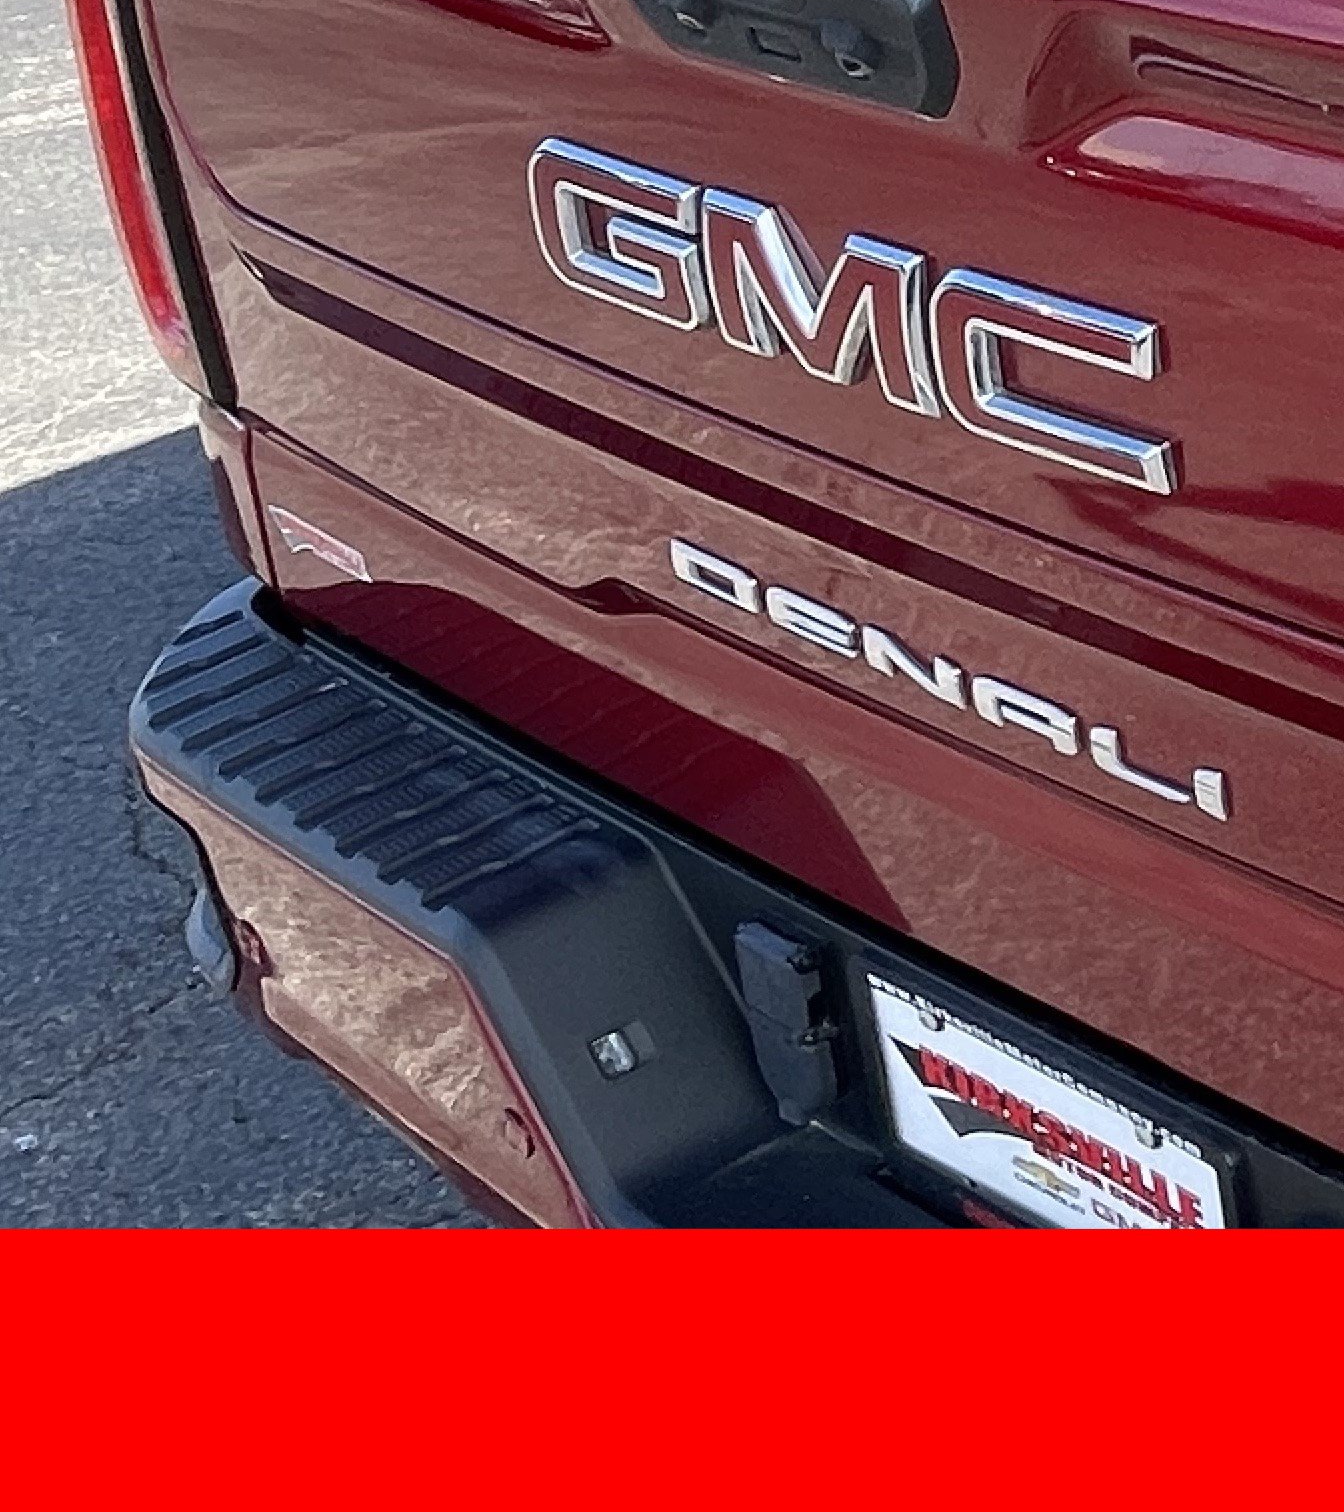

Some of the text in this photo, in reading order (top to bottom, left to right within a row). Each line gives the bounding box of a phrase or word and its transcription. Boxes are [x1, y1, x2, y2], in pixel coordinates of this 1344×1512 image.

[527, 136, 1173, 497] GMC
[669, 536, 1228, 823] DENALI
[918, 1043, 1204, 1228] KIRKSVILLE
